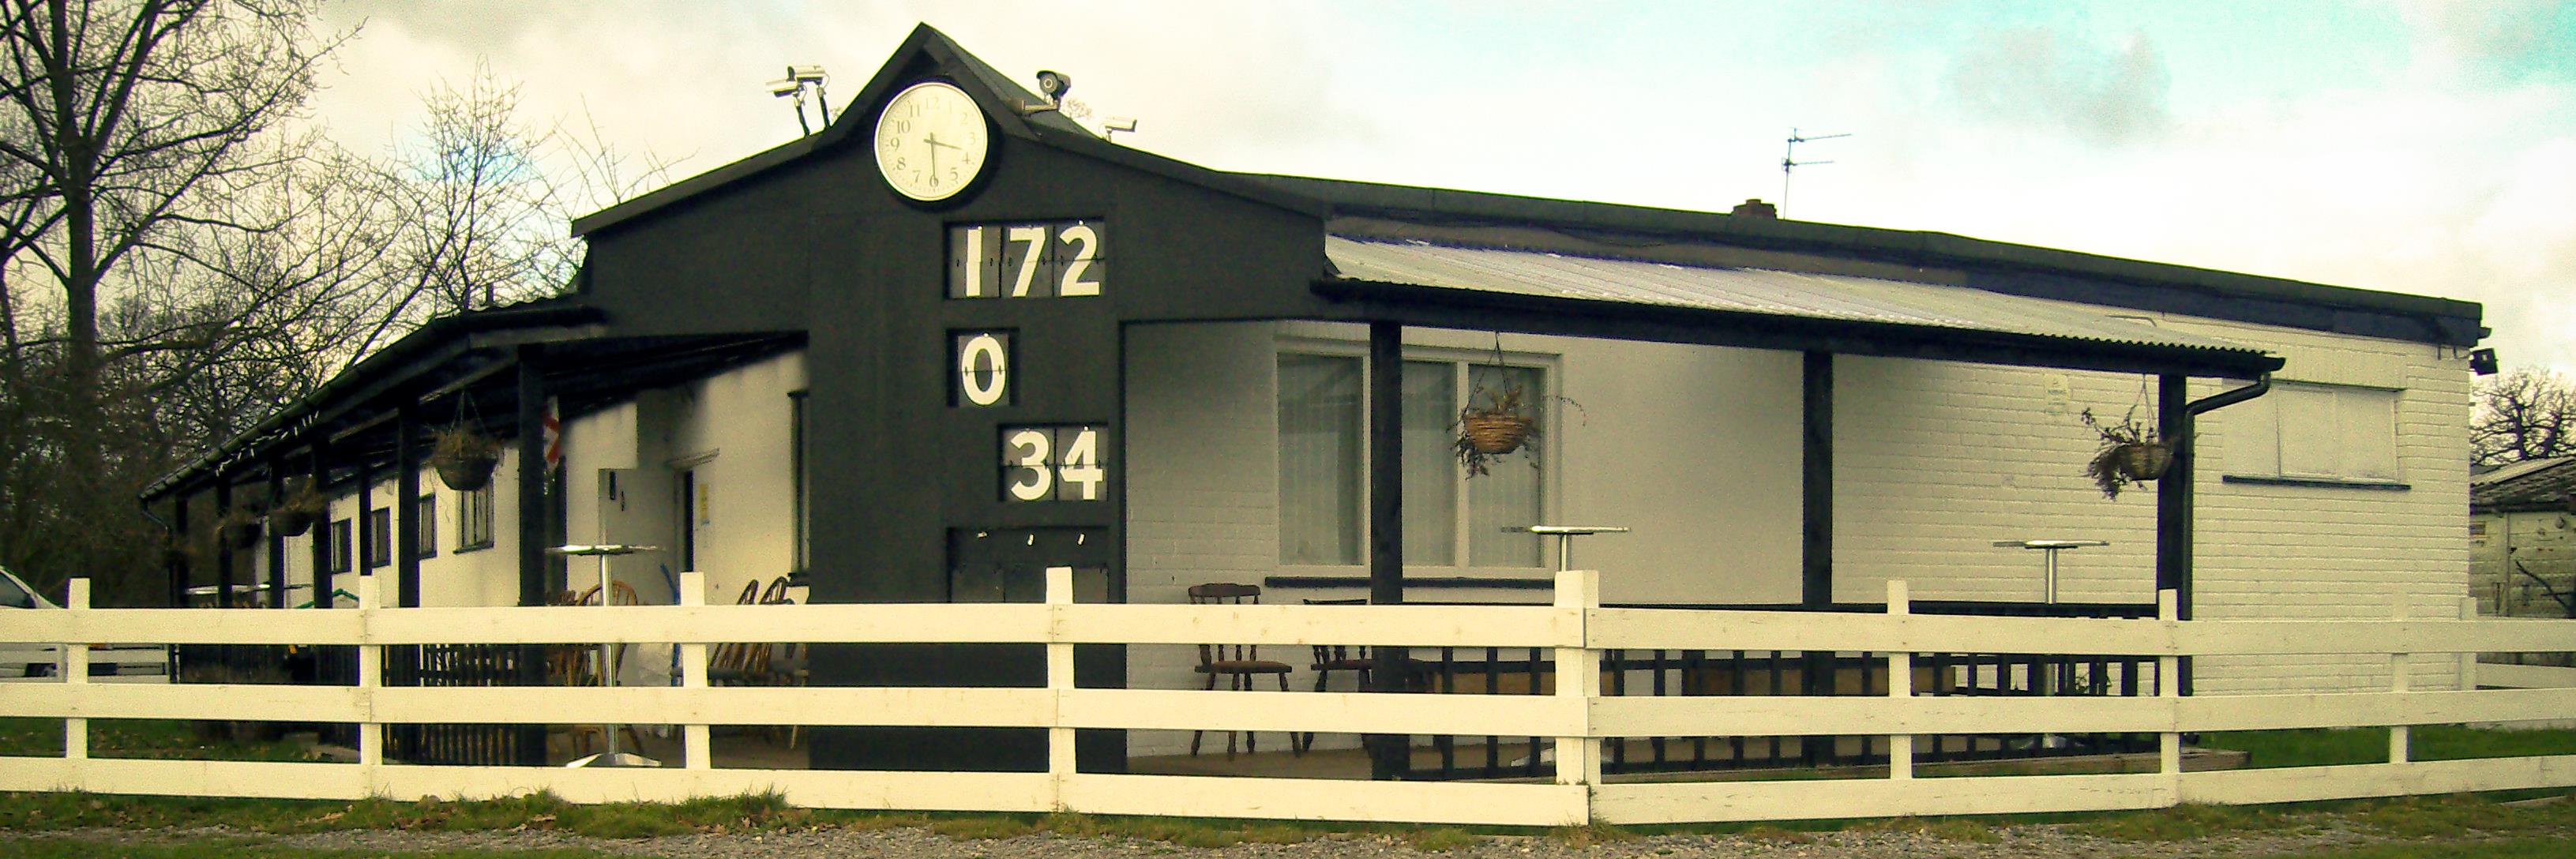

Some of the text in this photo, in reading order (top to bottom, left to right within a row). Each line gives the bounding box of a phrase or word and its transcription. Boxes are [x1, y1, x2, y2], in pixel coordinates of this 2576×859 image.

[910, 105, 921, 118] 11
[897, 120, 911, 133] 10
[890, 137, 900, 152] 9
[896, 157, 906, 171] 8
[961, 152, 971, 164] 4
[913, 170, 921, 183] 7
[929, 174, 939, 187] 6
[949, 167, 959, 181] 5
[966, 225, 1101, 297] 172
[961, 335, 1006, 406] 0
[1010, 430, 1104, 501] 34
